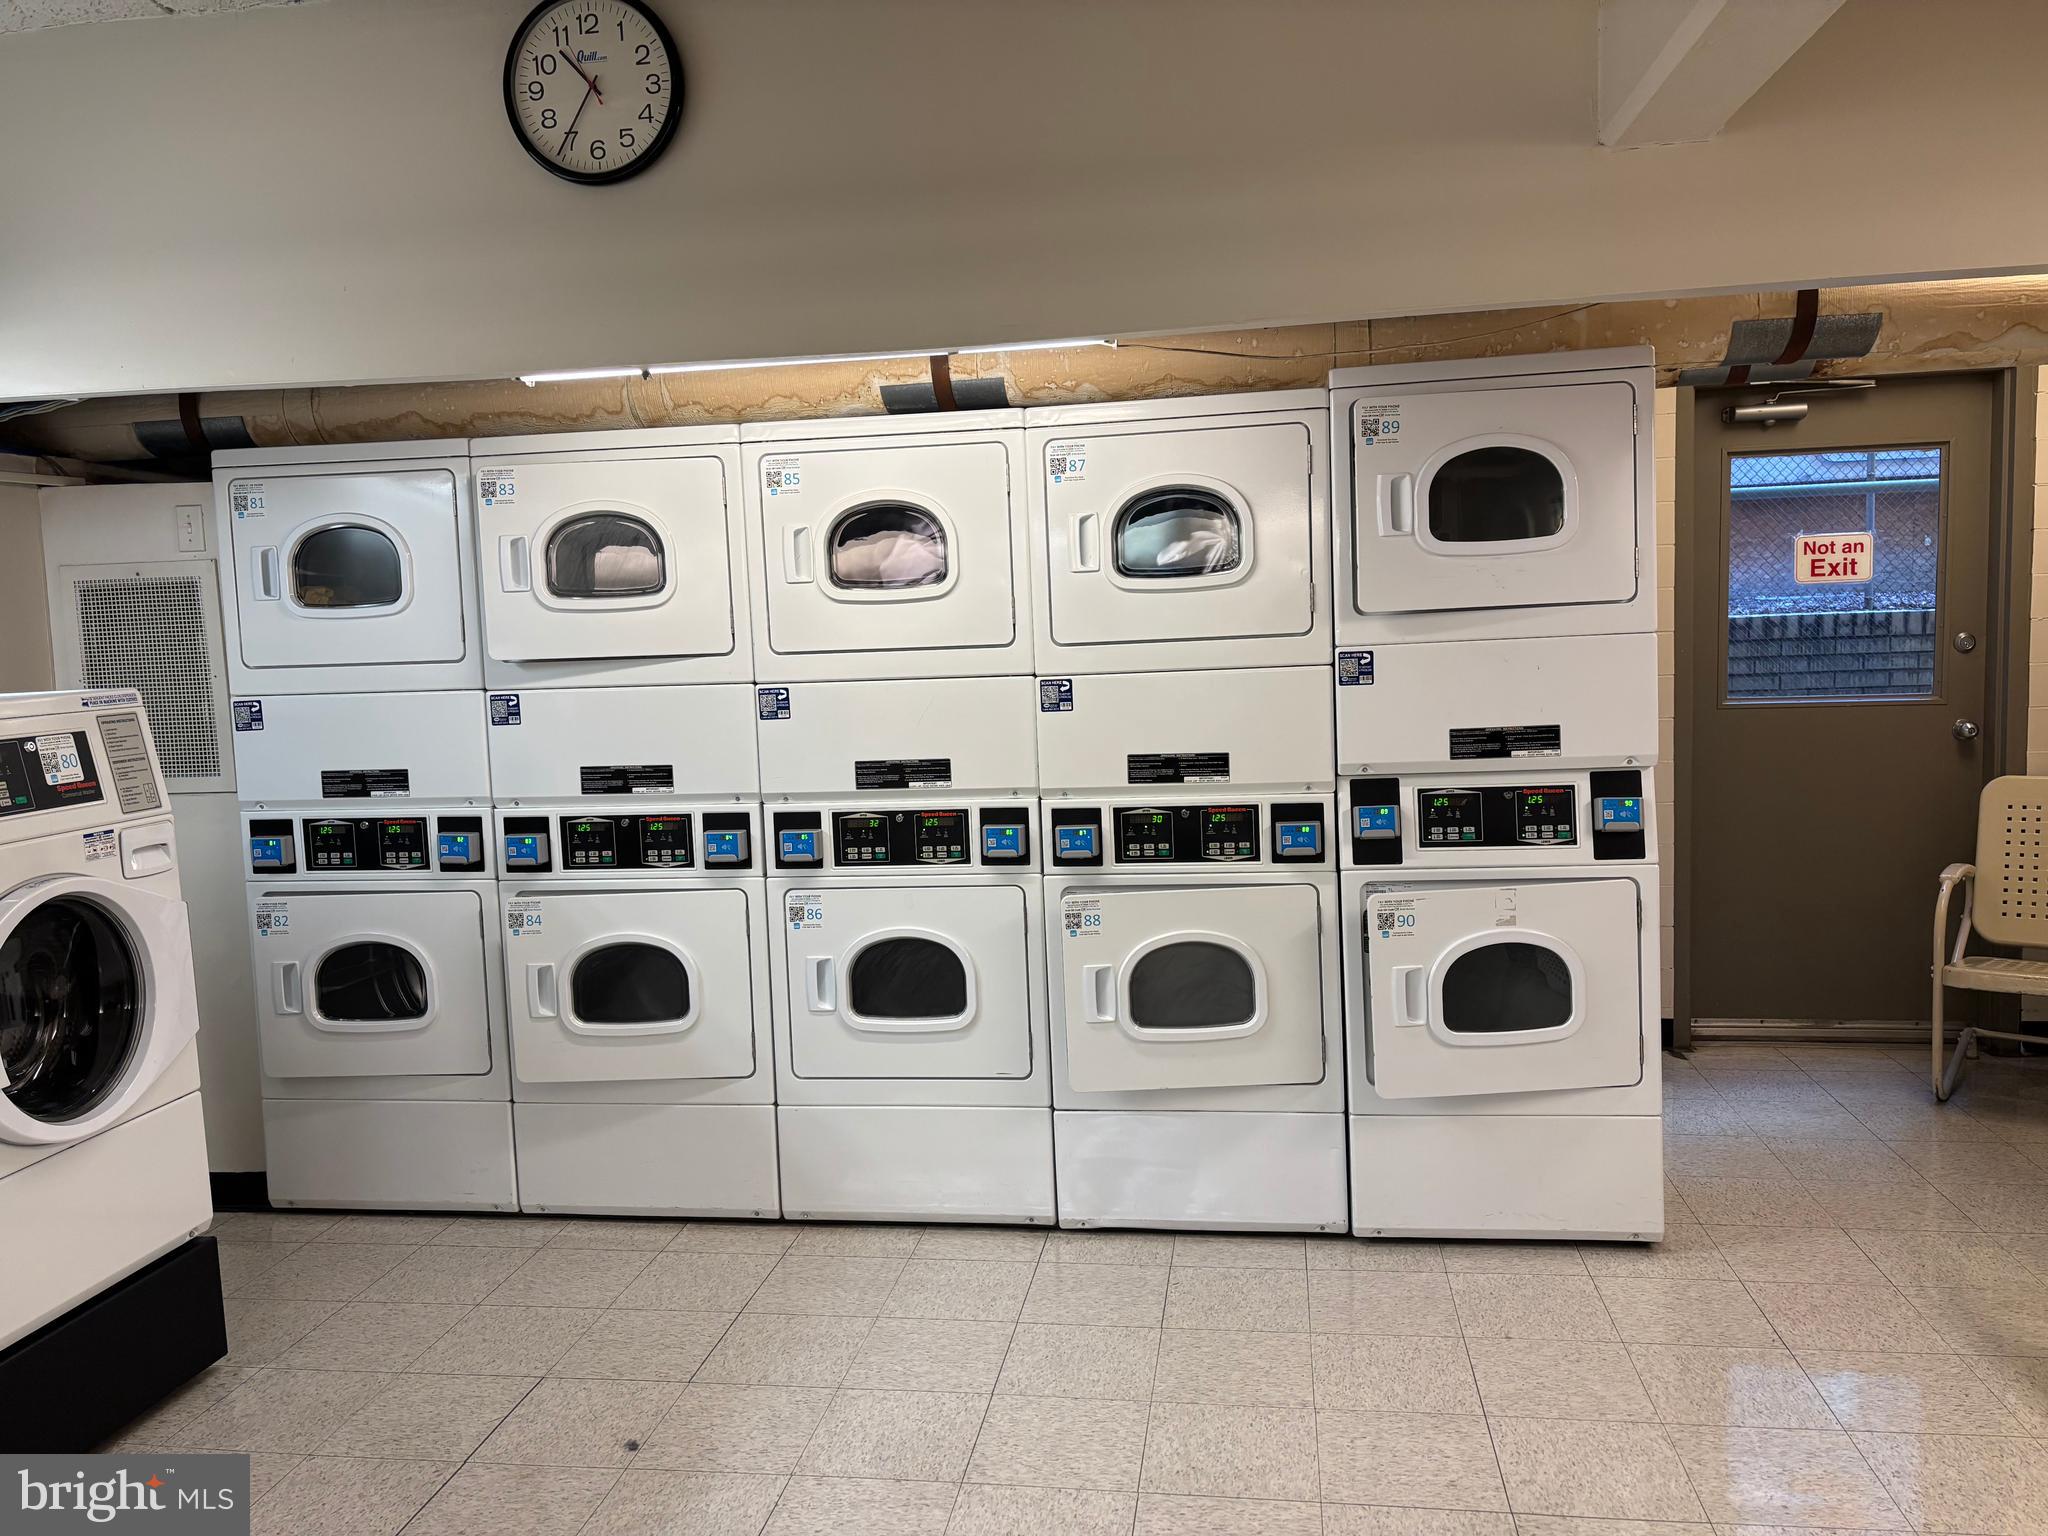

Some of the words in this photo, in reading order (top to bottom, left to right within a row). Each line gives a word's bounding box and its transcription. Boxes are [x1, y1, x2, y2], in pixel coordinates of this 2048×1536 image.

[576, 14, 599, 35] 12
[617, 20, 623, 41] 1
[553, 25, 569, 47] 11
[635, 45, 650, 65] 2
[532, 54, 557, 75] 10
[528, 81, 544, 101] 9
[645, 74, 661, 94] 3
[541, 109, 557, 129] 8
[638, 103, 654, 123] 4
[564, 131, 578, 151] 7
[619, 128, 635, 148] 5
[590, 140, 606, 160] 6
[1382, 420, 1400, 434] 89
[1069, 459, 1085, 472] 87
[784, 473, 800, 485] 85
[499, 483, 515, 495] 83
[250, 497, 264, 509] 81
[1804, 541, 1836, 555] Not
[1842, 543, 1864, 554] an
[1810, 558, 1858, 577] Exit
[61, 753, 78, 769] 80
[869, 819, 879, 828] 32
[1152, 815, 1162, 823] 30
[274, 915, 288, 927] 82
[526, 914, 542, 926] 84
[807, 908, 822, 920] 86
[1084, 914, 1101, 926] 88
[1397, 914, 1415, 928] 90
